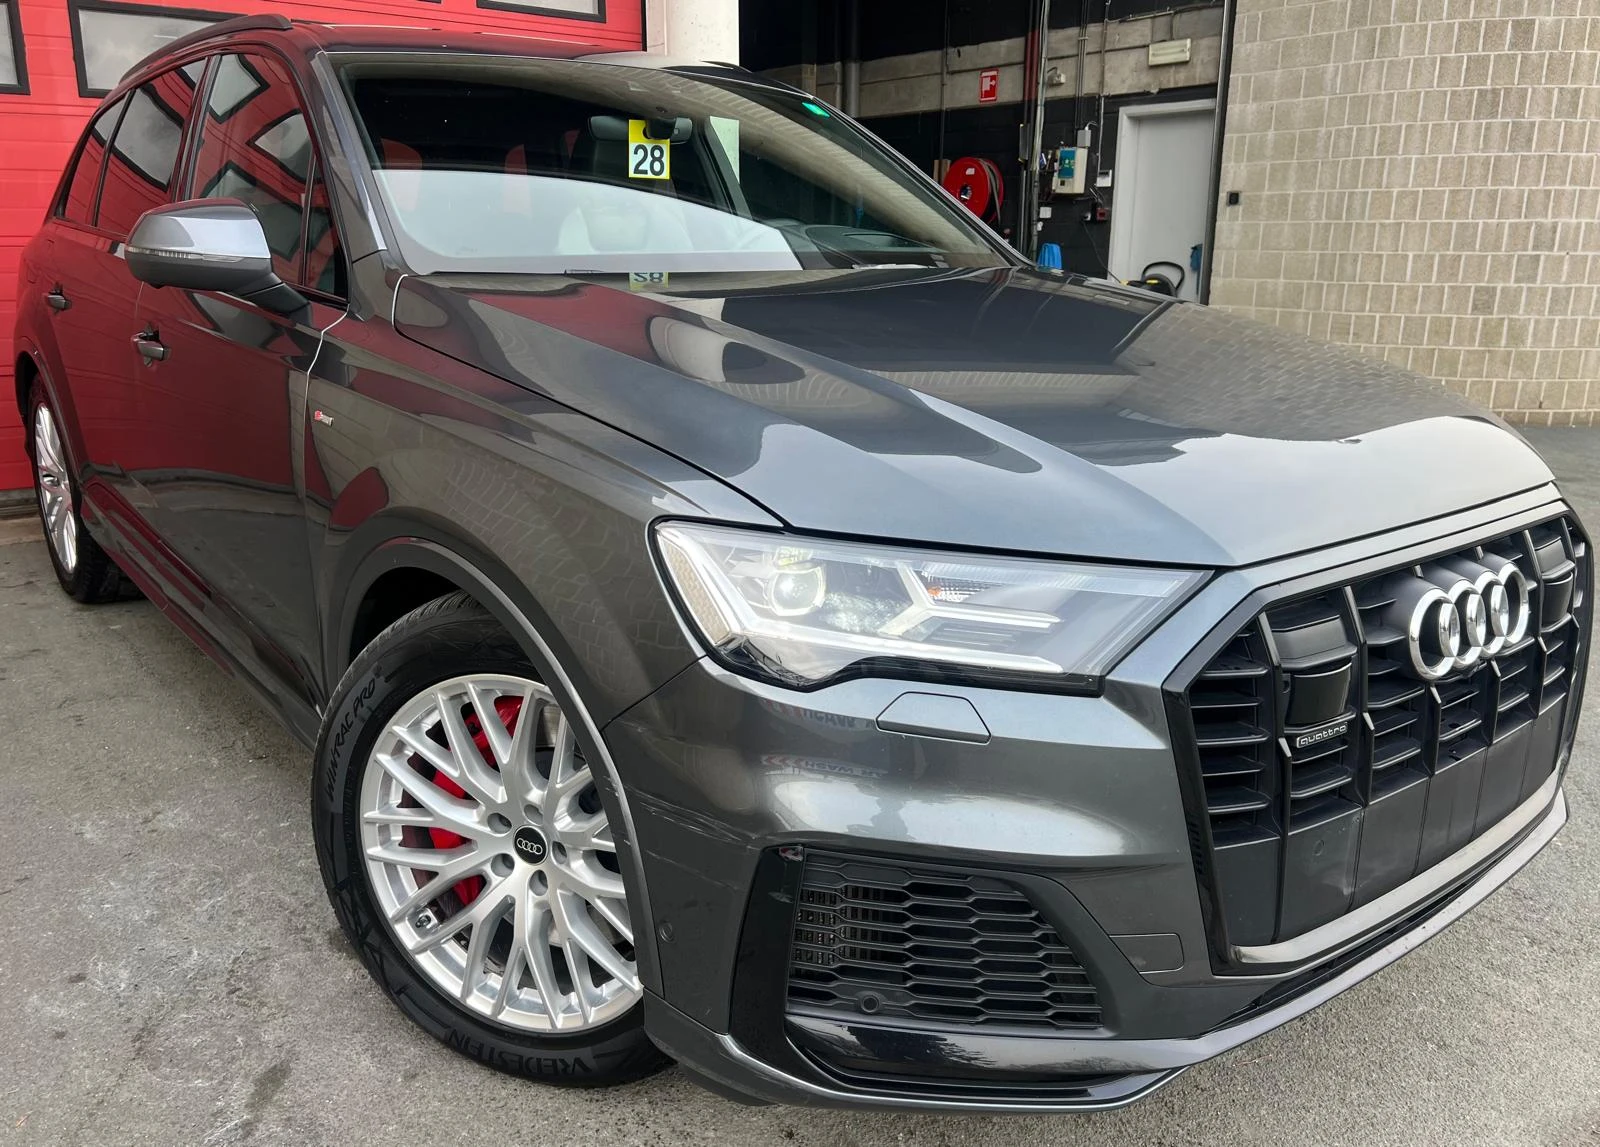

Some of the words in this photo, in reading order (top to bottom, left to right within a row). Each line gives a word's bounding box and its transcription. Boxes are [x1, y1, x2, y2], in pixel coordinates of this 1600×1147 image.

[633, 144, 665, 176] 28
[324, 712, 354, 802] WINTRAC
[353, 677, 376, 718] PRO
[1300, 724, 1347, 746] quattro
[448, 1028, 593, 1076] VREDESTEIN
